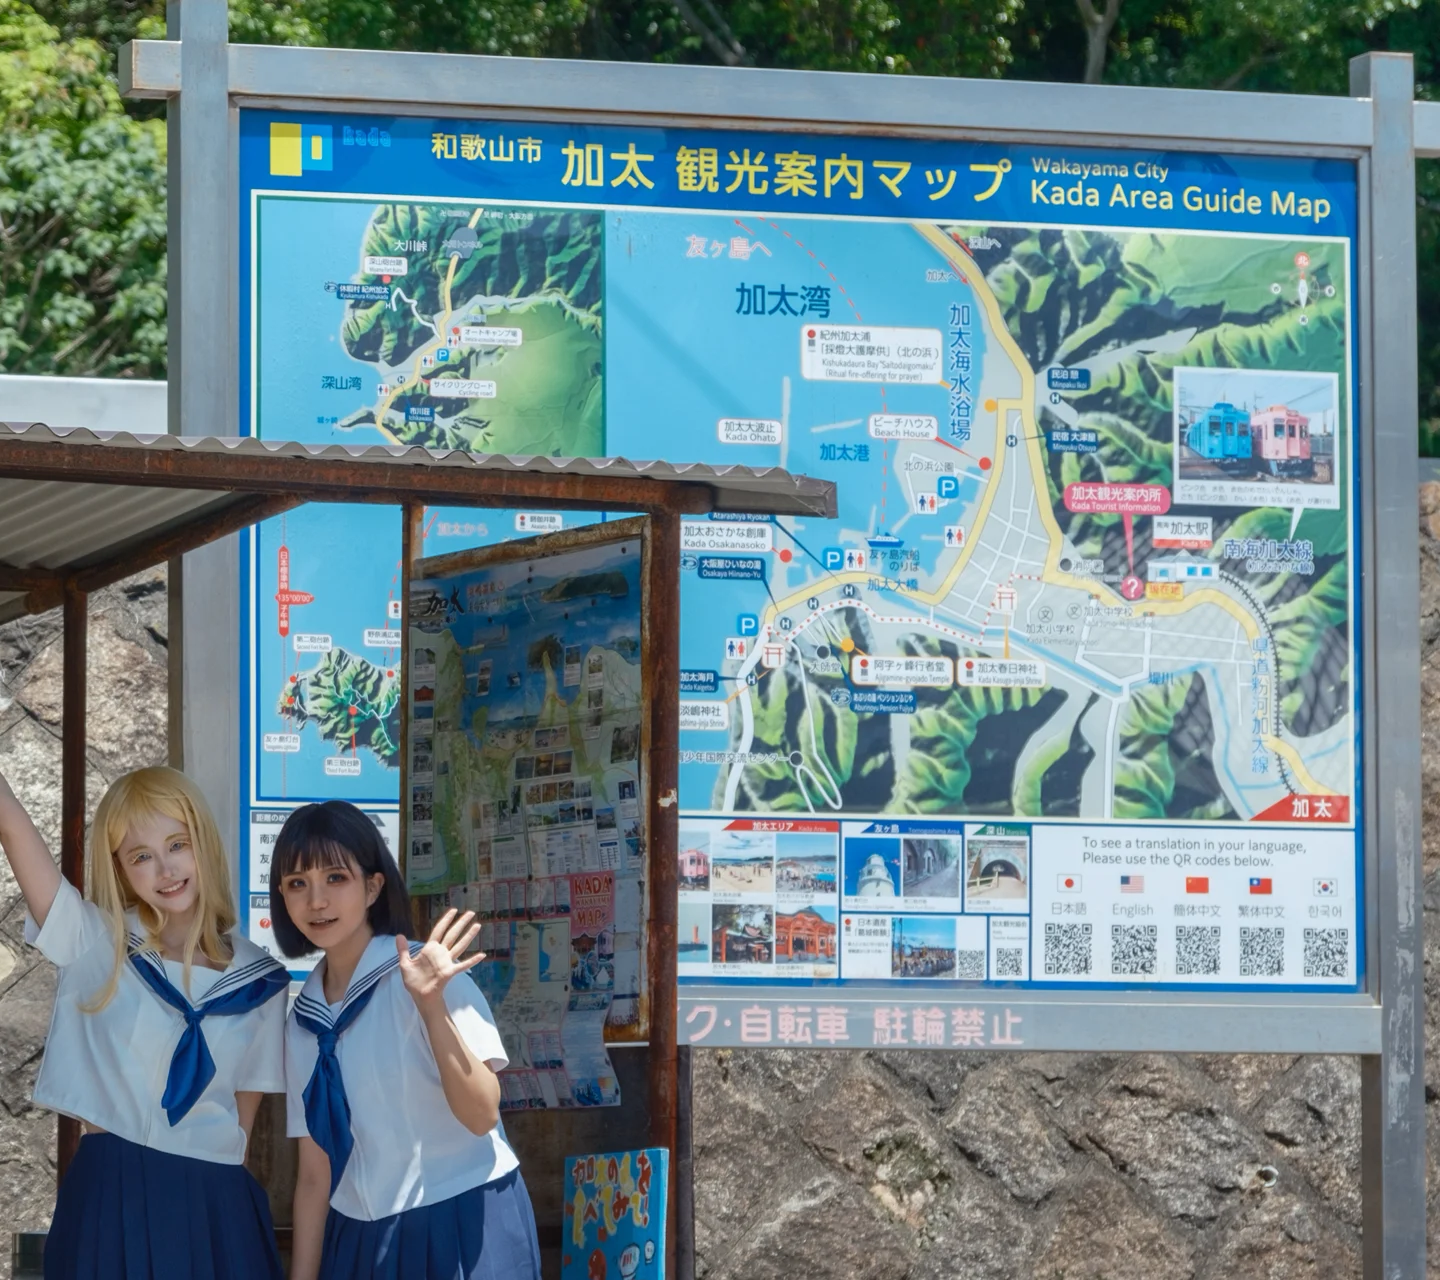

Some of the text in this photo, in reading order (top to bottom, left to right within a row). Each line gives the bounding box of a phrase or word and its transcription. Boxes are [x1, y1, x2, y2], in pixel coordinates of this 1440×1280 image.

[431, 132, 1013, 202] 和歌山市 加太 観光案内マップ
[1031, 157, 1169, 182] Wakayama City
[1031, 179, 1331, 223] Kada Area Guide Map
[686, 235, 772, 260] 友ヶ島へ
[735, 282, 832, 319] 加太湾
[819, 330, 871, 342] 紀州加太浦
[949, 303, 972, 441] 加太海水浴場
[321, 376, 362, 391] 深山湾
[433, 381, 494, 390] サイクリングロード
[724, 421, 776, 434] 加太大波止
[873, 417, 935, 429] ビーチハウス
[725, 433, 748, 441] Kada
[874, 428, 930, 438] Beach House
[1051, 432, 1097, 444] 民宿 大津屋
[819, 443, 870, 462] 加太港
[903, 461, 955, 473] 北の浜公園
[1071, 485, 1162, 503] 加太観光案内所
[1071, 501, 1161, 513] Kada Tourist Information
[683, 525, 767, 539] 加太おさかな創庫
[1170, 520, 1209, 537] 加太駅
[684, 539, 766, 549] Kada Osakanasoko
[1224, 539, 1313, 560] 南海加太線
[869, 549, 920, 561] 友ヶ島汽船
[889, 561, 920, 571] のりば
[867, 578, 919, 592] 加太大橋
[1083, 605, 1134, 617] 加太中学校
[1026, 623, 1075, 635] 加太小学校
[873, 660, 945, 673] 阿字ヶ峰行者堂
[977, 663, 1038, 675] 加太春日神社
[1292, 798, 1333, 819] 加太
[752, 821, 793, 832] 加太エリア
[873, 824, 900, 834] 友ヶ島
[1082, 836, 1307, 855] To see translation in your language,
[1082, 852, 1274, 868] Please use the QR codes below.
[573, 875, 612, 896] KADA
[1051, 902, 1087, 915] 日本語
[1111, 903, 1154, 919] English
[1173, 903, 1222, 918] 簡体中文
[1237, 904, 1286, 919] 繁体中文
[872, 1006, 1024, 1046] 駐輪禁止
